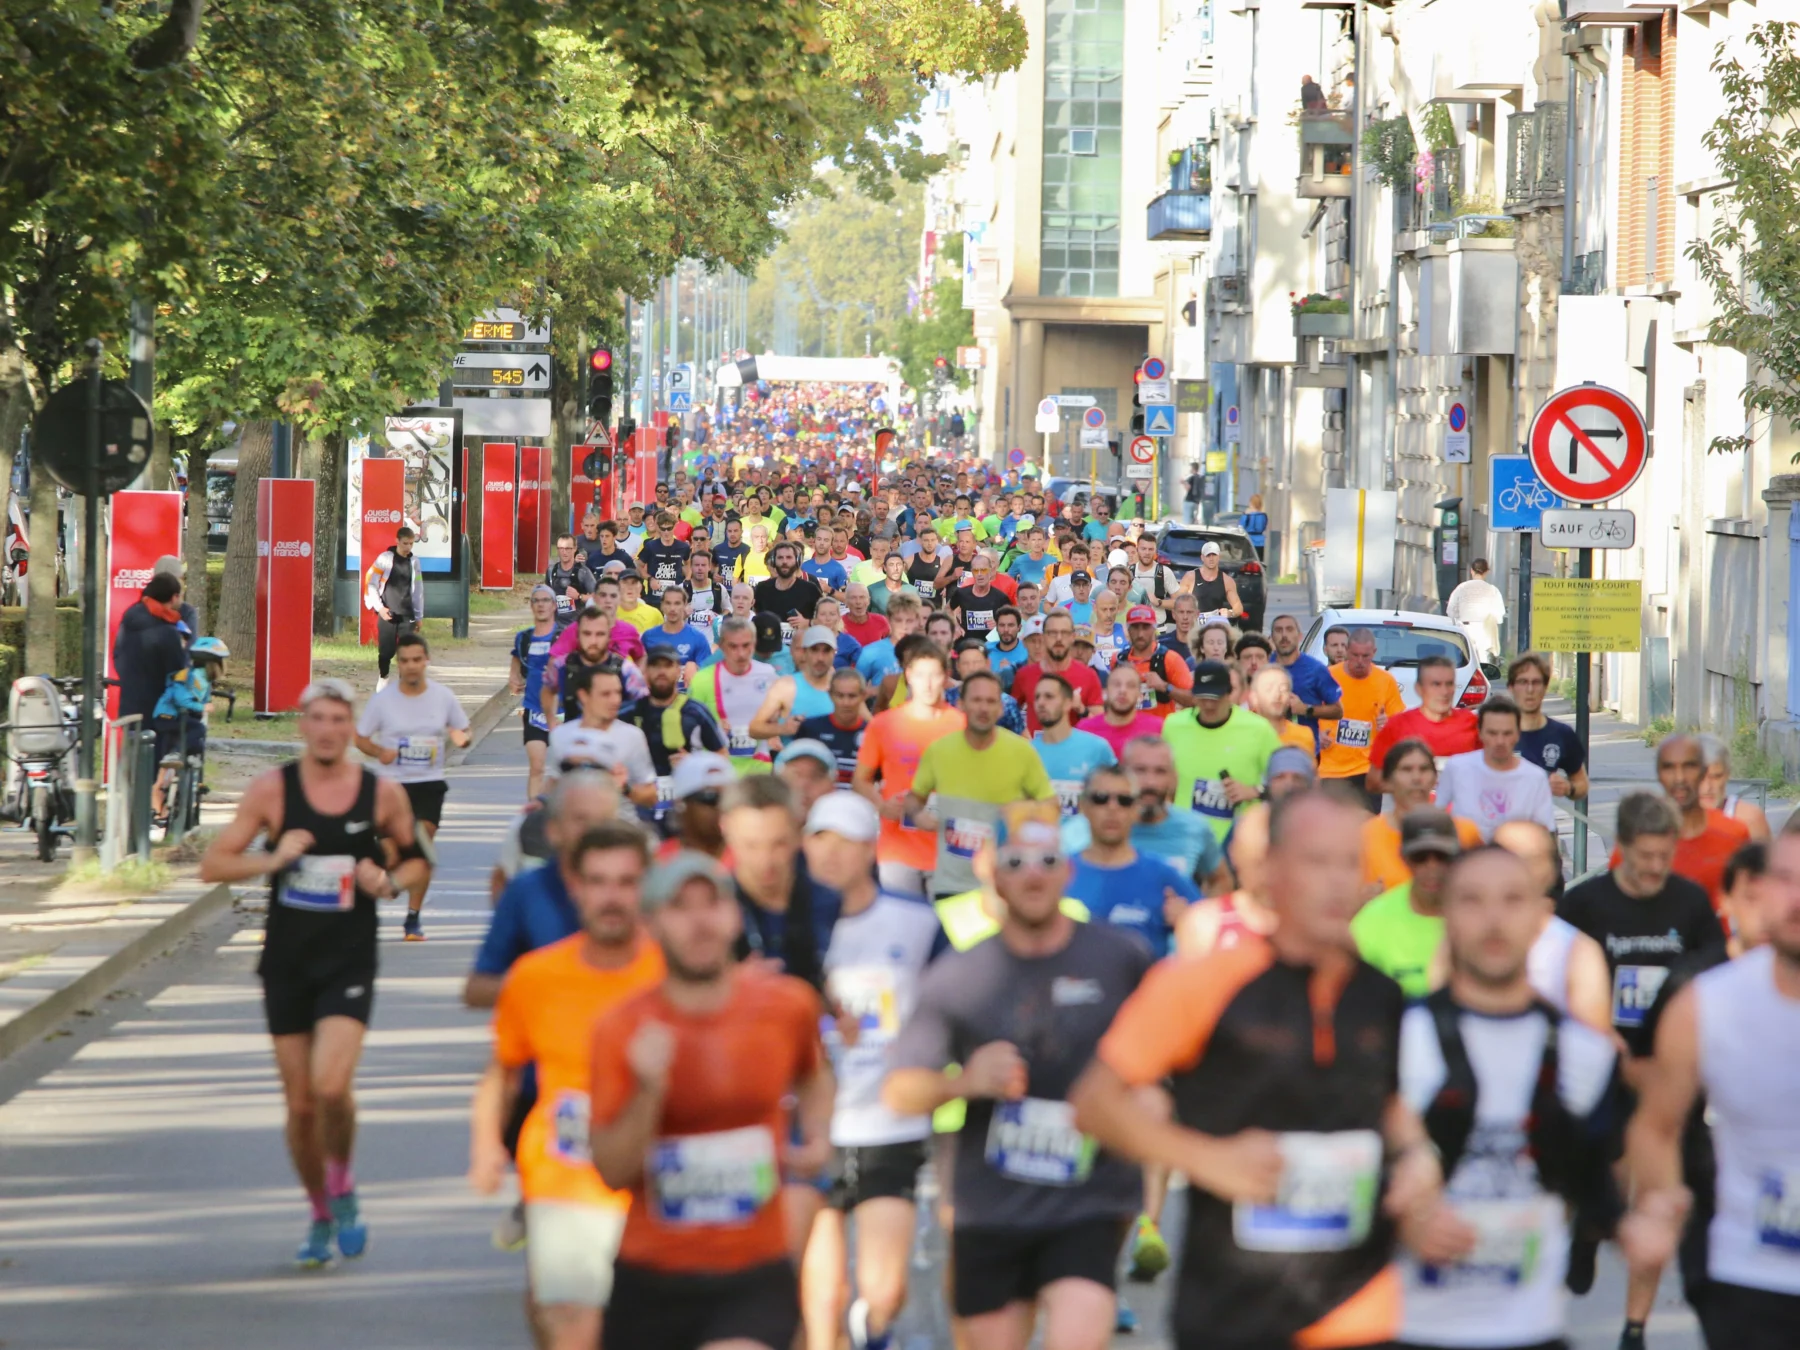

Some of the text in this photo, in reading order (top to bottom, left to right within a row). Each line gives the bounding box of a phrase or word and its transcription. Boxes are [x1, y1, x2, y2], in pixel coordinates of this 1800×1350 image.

[492, 369, 522, 384] 545
[368, 508, 389, 517] ouest
[364, 514, 390, 523] france
[1550, 523, 1584, 534] SAUF
[276, 540, 299, 550] ouest
[273, 547, 300, 557] france
[113, 576, 152, 589] franc
[1339, 728, 1368, 741] 10733
